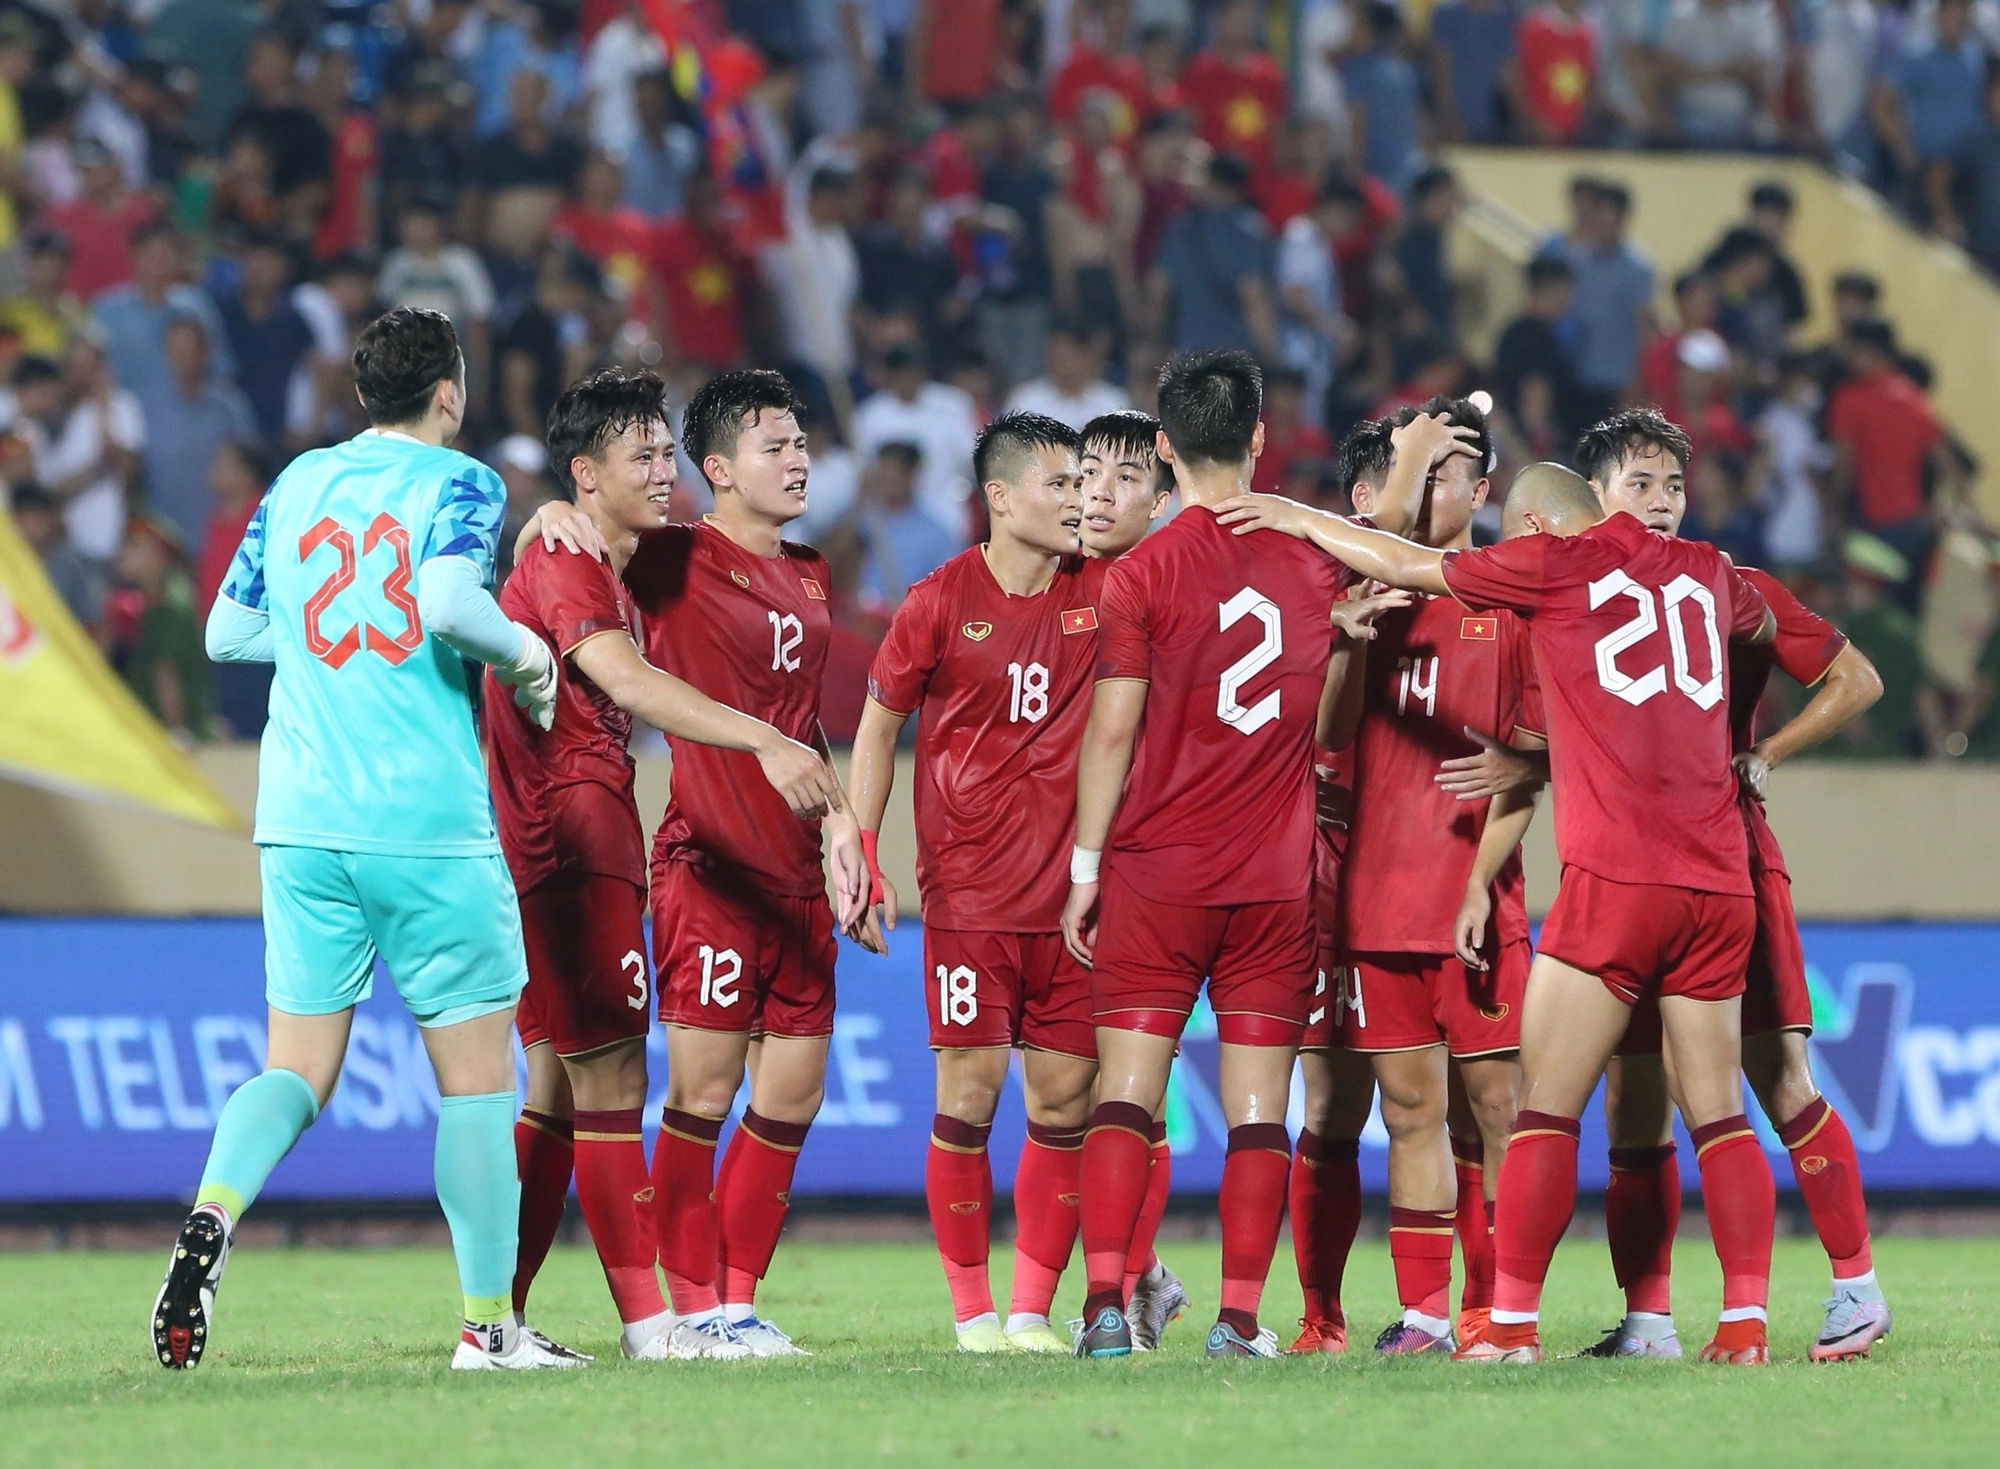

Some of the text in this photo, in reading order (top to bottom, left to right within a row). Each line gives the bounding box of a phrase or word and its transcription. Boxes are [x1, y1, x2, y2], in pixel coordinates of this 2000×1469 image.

[300, 512, 424, 670] 23
[767, 610, 803, 673] 12
[1217, 586, 1282, 736] 2
[1588, 568, 1725, 711] 20
[1007, 661, 1049, 723] 18
[1398, 655, 1439, 717] 14
[620, 949, 648, 1010] 3
[699, 944, 743, 1008] 12
[936, 963, 978, 1027] 18
